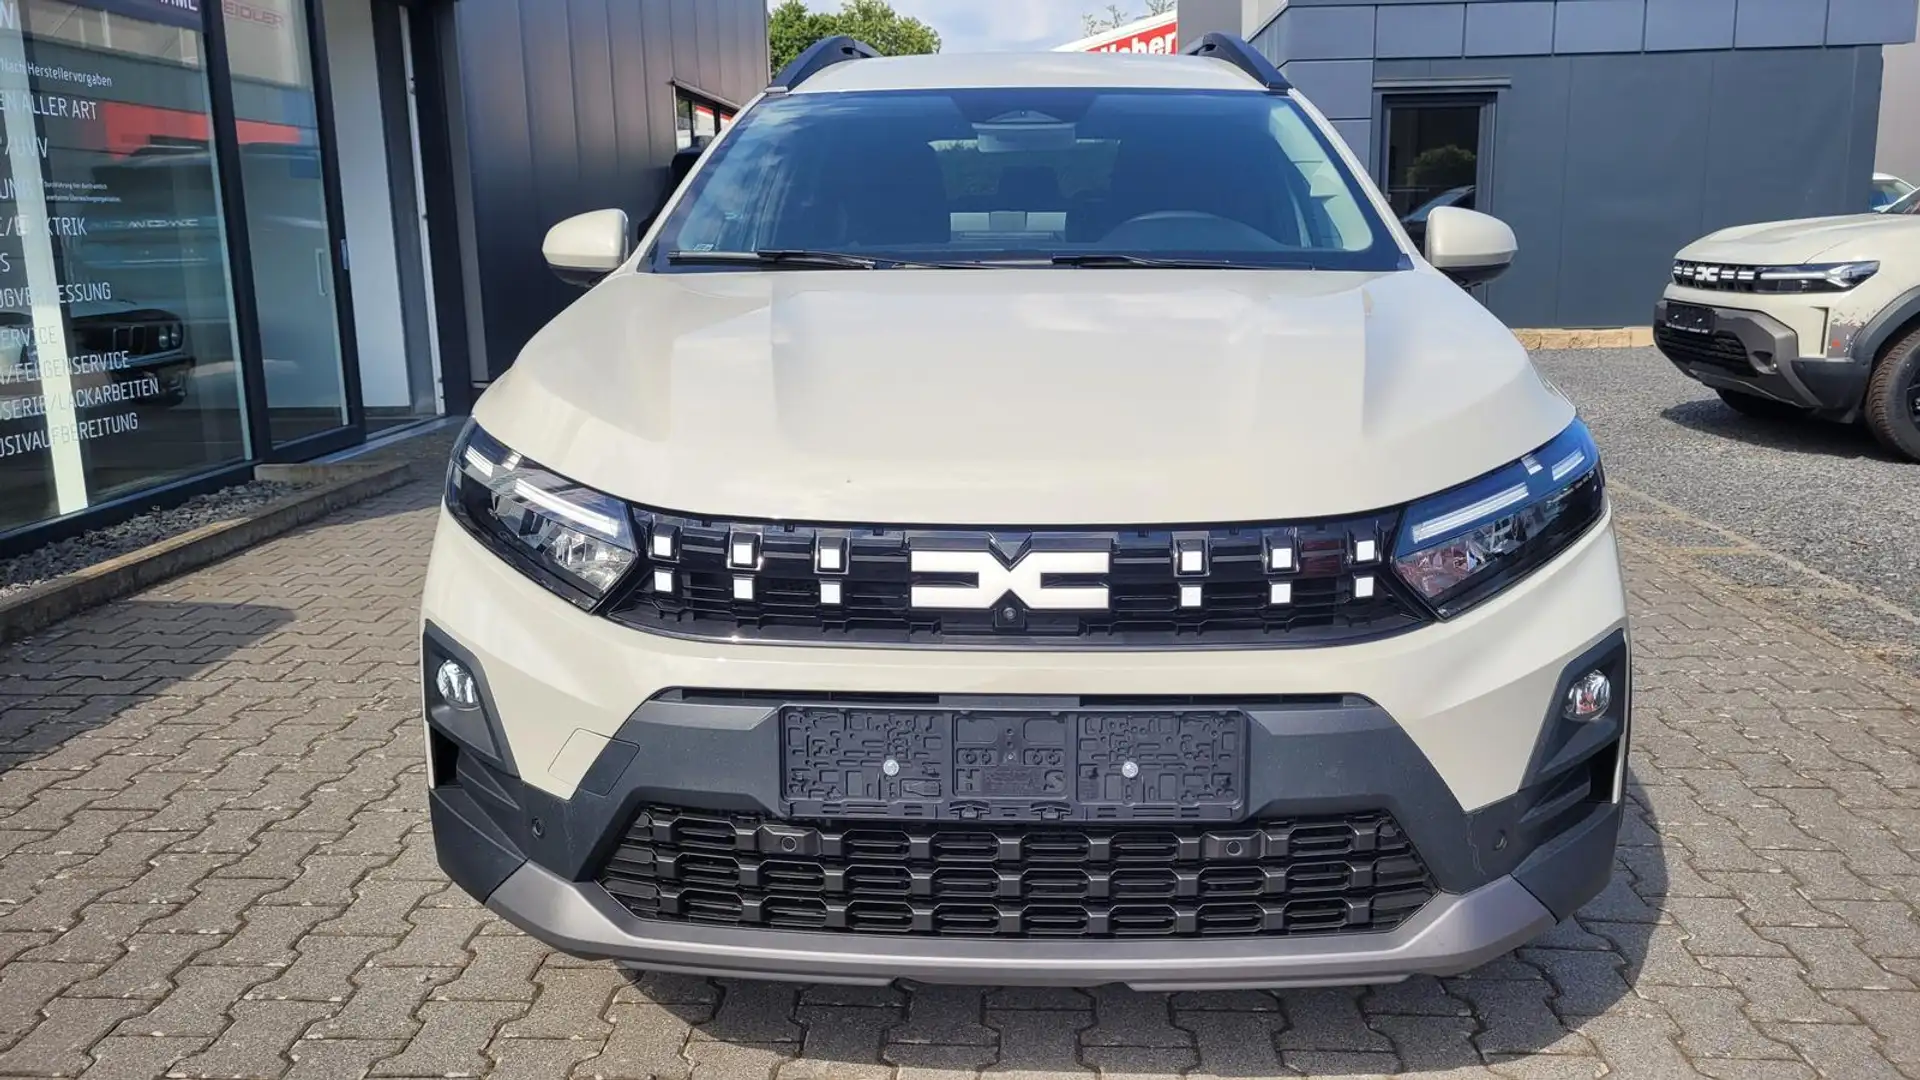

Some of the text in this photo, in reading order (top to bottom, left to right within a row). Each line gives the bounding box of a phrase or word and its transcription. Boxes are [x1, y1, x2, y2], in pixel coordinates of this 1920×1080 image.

[1098, 31, 1177, 55] ber
[27, 62, 113, 87] Herstellervorgaben
[22, 94, 68, 118] ALLER
[72, 99, 97, 122] ART
[0, 377, 159, 421] SERIE/LACKARBEITEN
